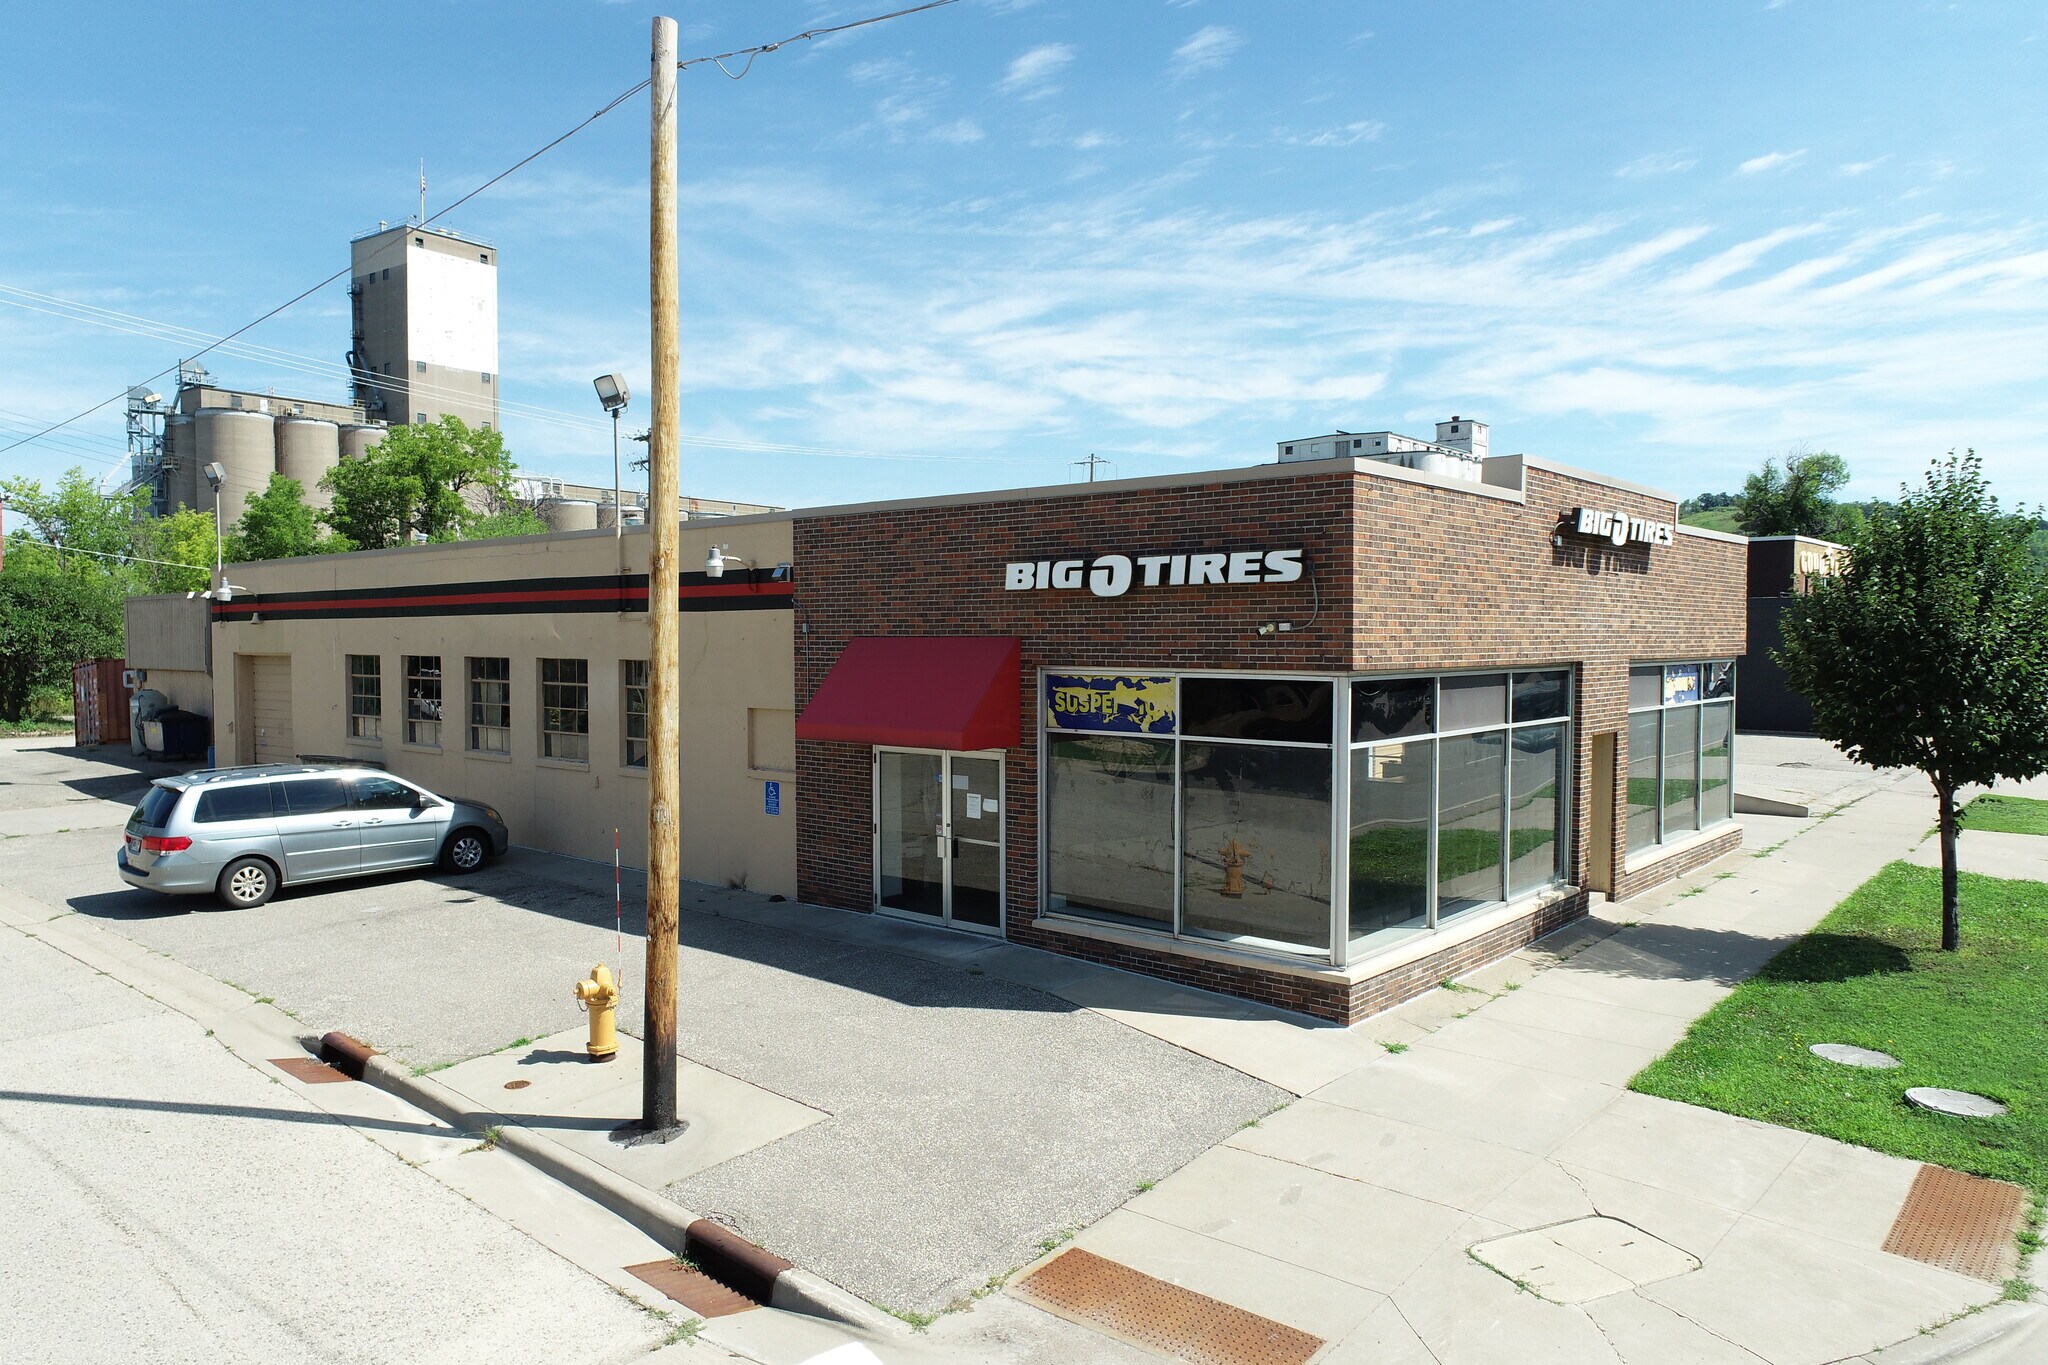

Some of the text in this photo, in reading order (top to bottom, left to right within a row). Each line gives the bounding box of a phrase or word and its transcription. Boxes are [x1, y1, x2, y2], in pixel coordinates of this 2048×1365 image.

[1577, 507, 1674, 546] BIG O TIRES
[1005, 549, 1303, 597] BIG O TIRES
